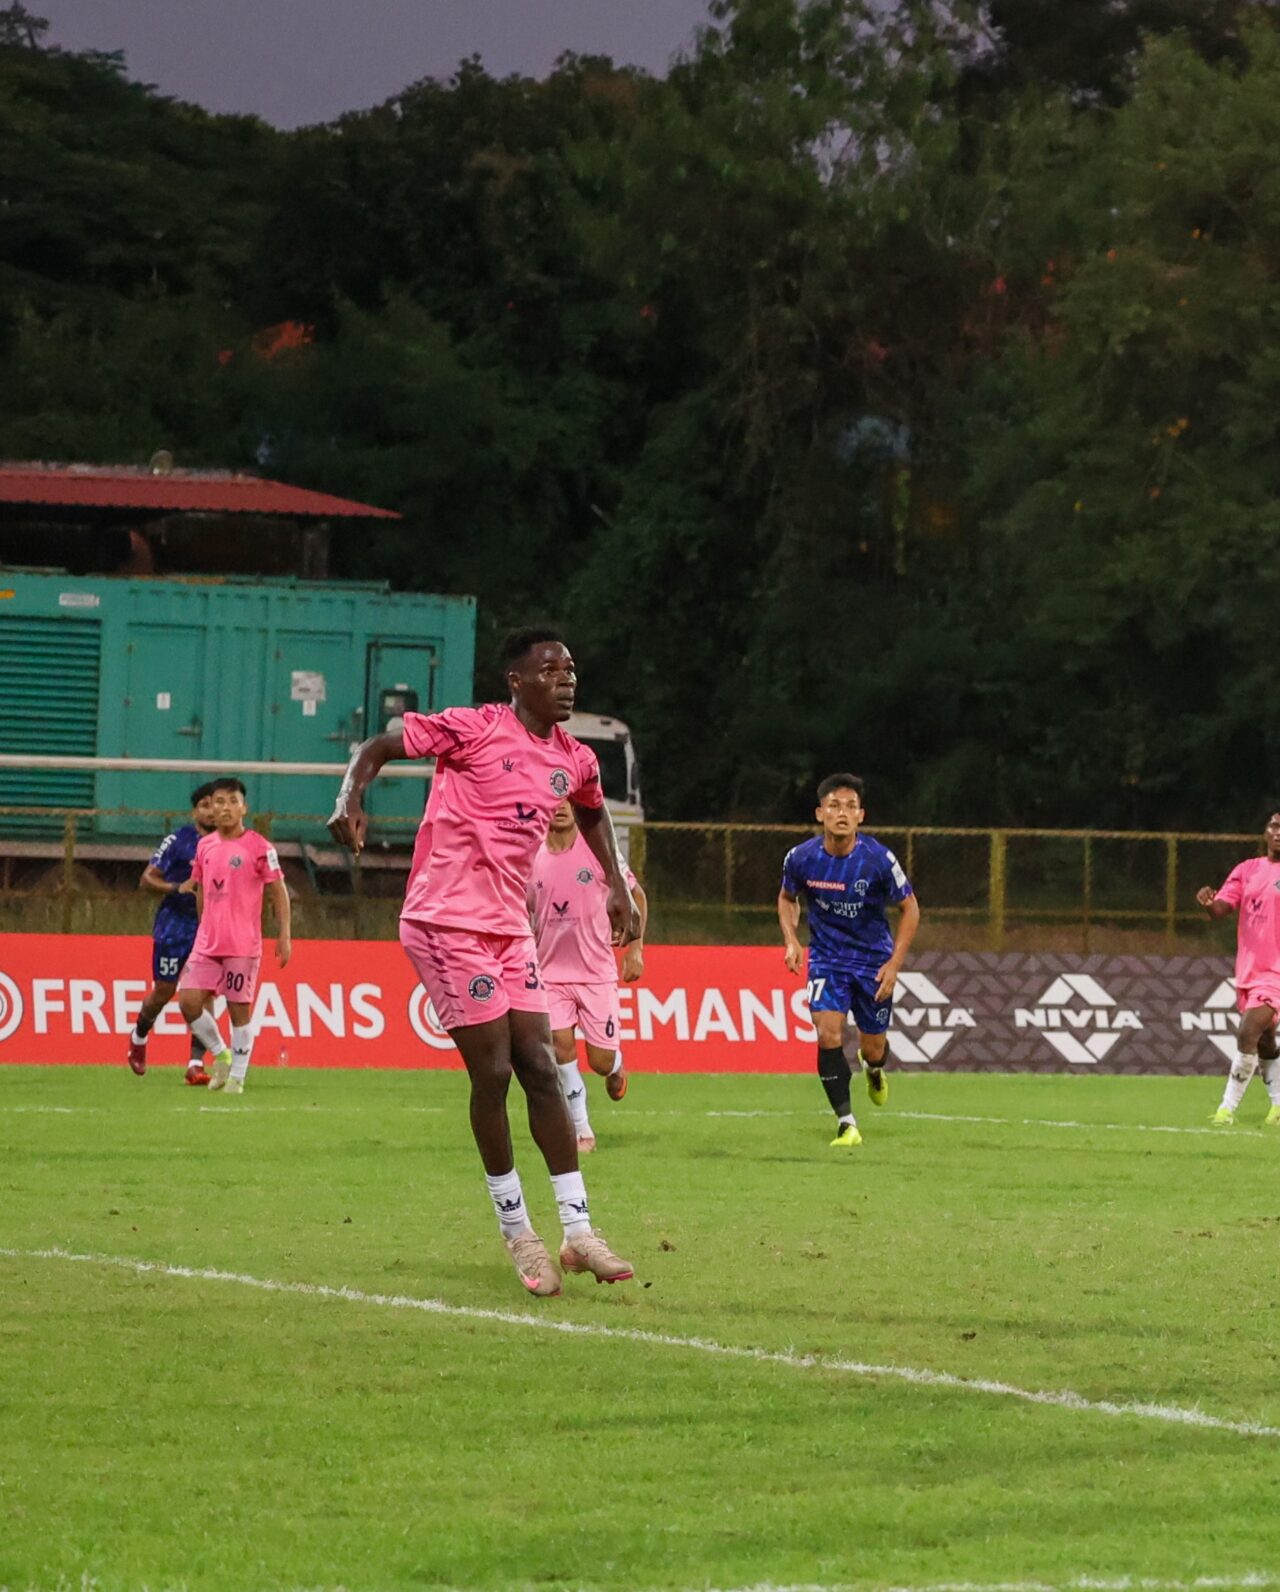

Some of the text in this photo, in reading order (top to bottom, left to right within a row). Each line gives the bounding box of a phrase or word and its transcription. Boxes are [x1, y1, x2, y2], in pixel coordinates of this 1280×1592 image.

[159, 957, 179, 976] 55
[525, 961, 545, 990] 3
[226, 971, 244, 992] 80
[605, 1014, 615, 1038] 6
[1014, 1008, 1144, 1029] NIVIA
